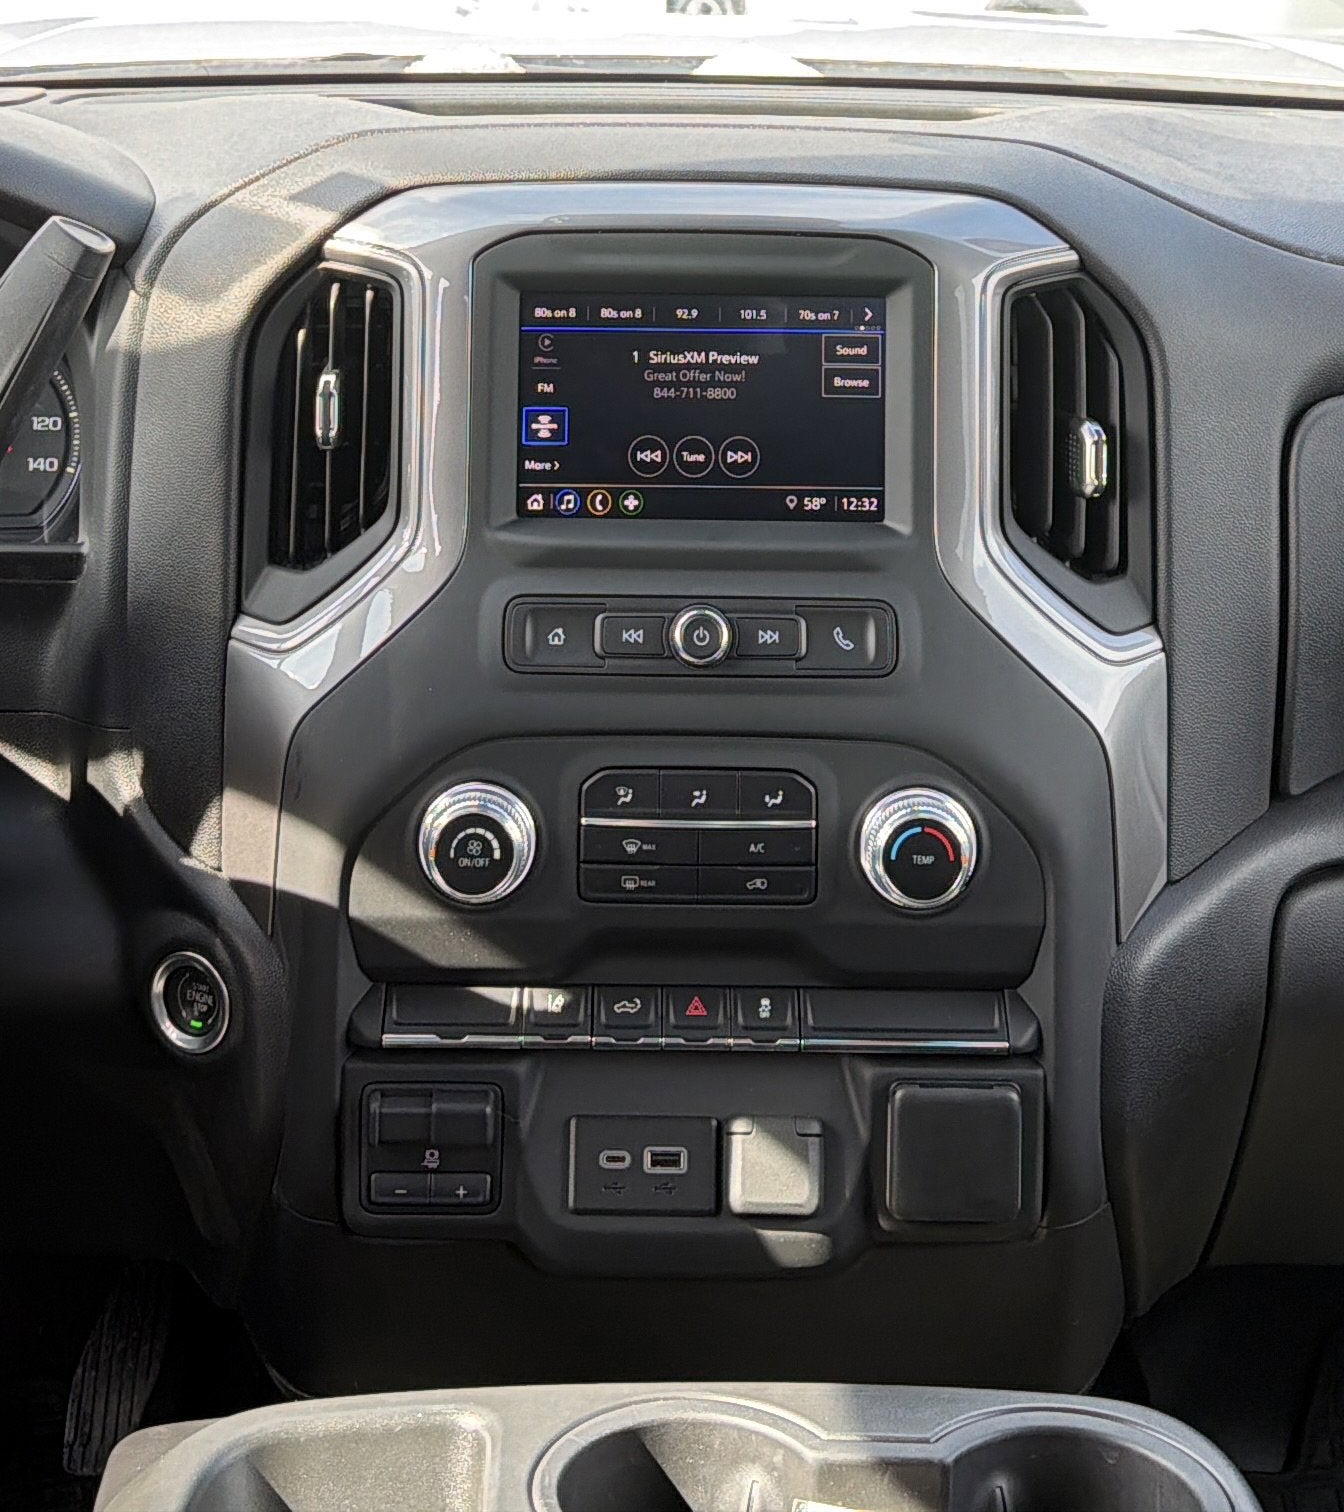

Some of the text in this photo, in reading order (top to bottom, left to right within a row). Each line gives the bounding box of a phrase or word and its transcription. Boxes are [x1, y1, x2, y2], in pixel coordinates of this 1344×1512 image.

[554, 309, 566, 319] on
[568, 307, 577, 319] 8
[600, 307, 642, 320] 80s on 8
[676, 308, 699, 320] 92.9
[739, 308, 767, 320] 101.5
[798, 309, 840, 321] 70s on 7
[835, 343, 868, 356] Sound
[632, 350, 760, 365] 1 SiriusXM Preview
[643, 369, 746, 383] Great Offer Now!
[537, 382, 554, 393] FM
[833, 376, 870, 389] Browse
[652, 387, 737, 401] 844-711-8800
[31, 416, 62, 431] 120
[681, 451, 706, 463] Tune
[27, 457, 59, 472] 140
[524, 459, 552, 472] More
[841, 497, 878, 512] 12:32
[642, 843, 656, 851] MAX
[749, 842, 766, 854] A/C
[458, 857, 491, 868] ON/OFF
[912, 854, 935, 866] TEMP
[640, 879, 656, 887] REAR
